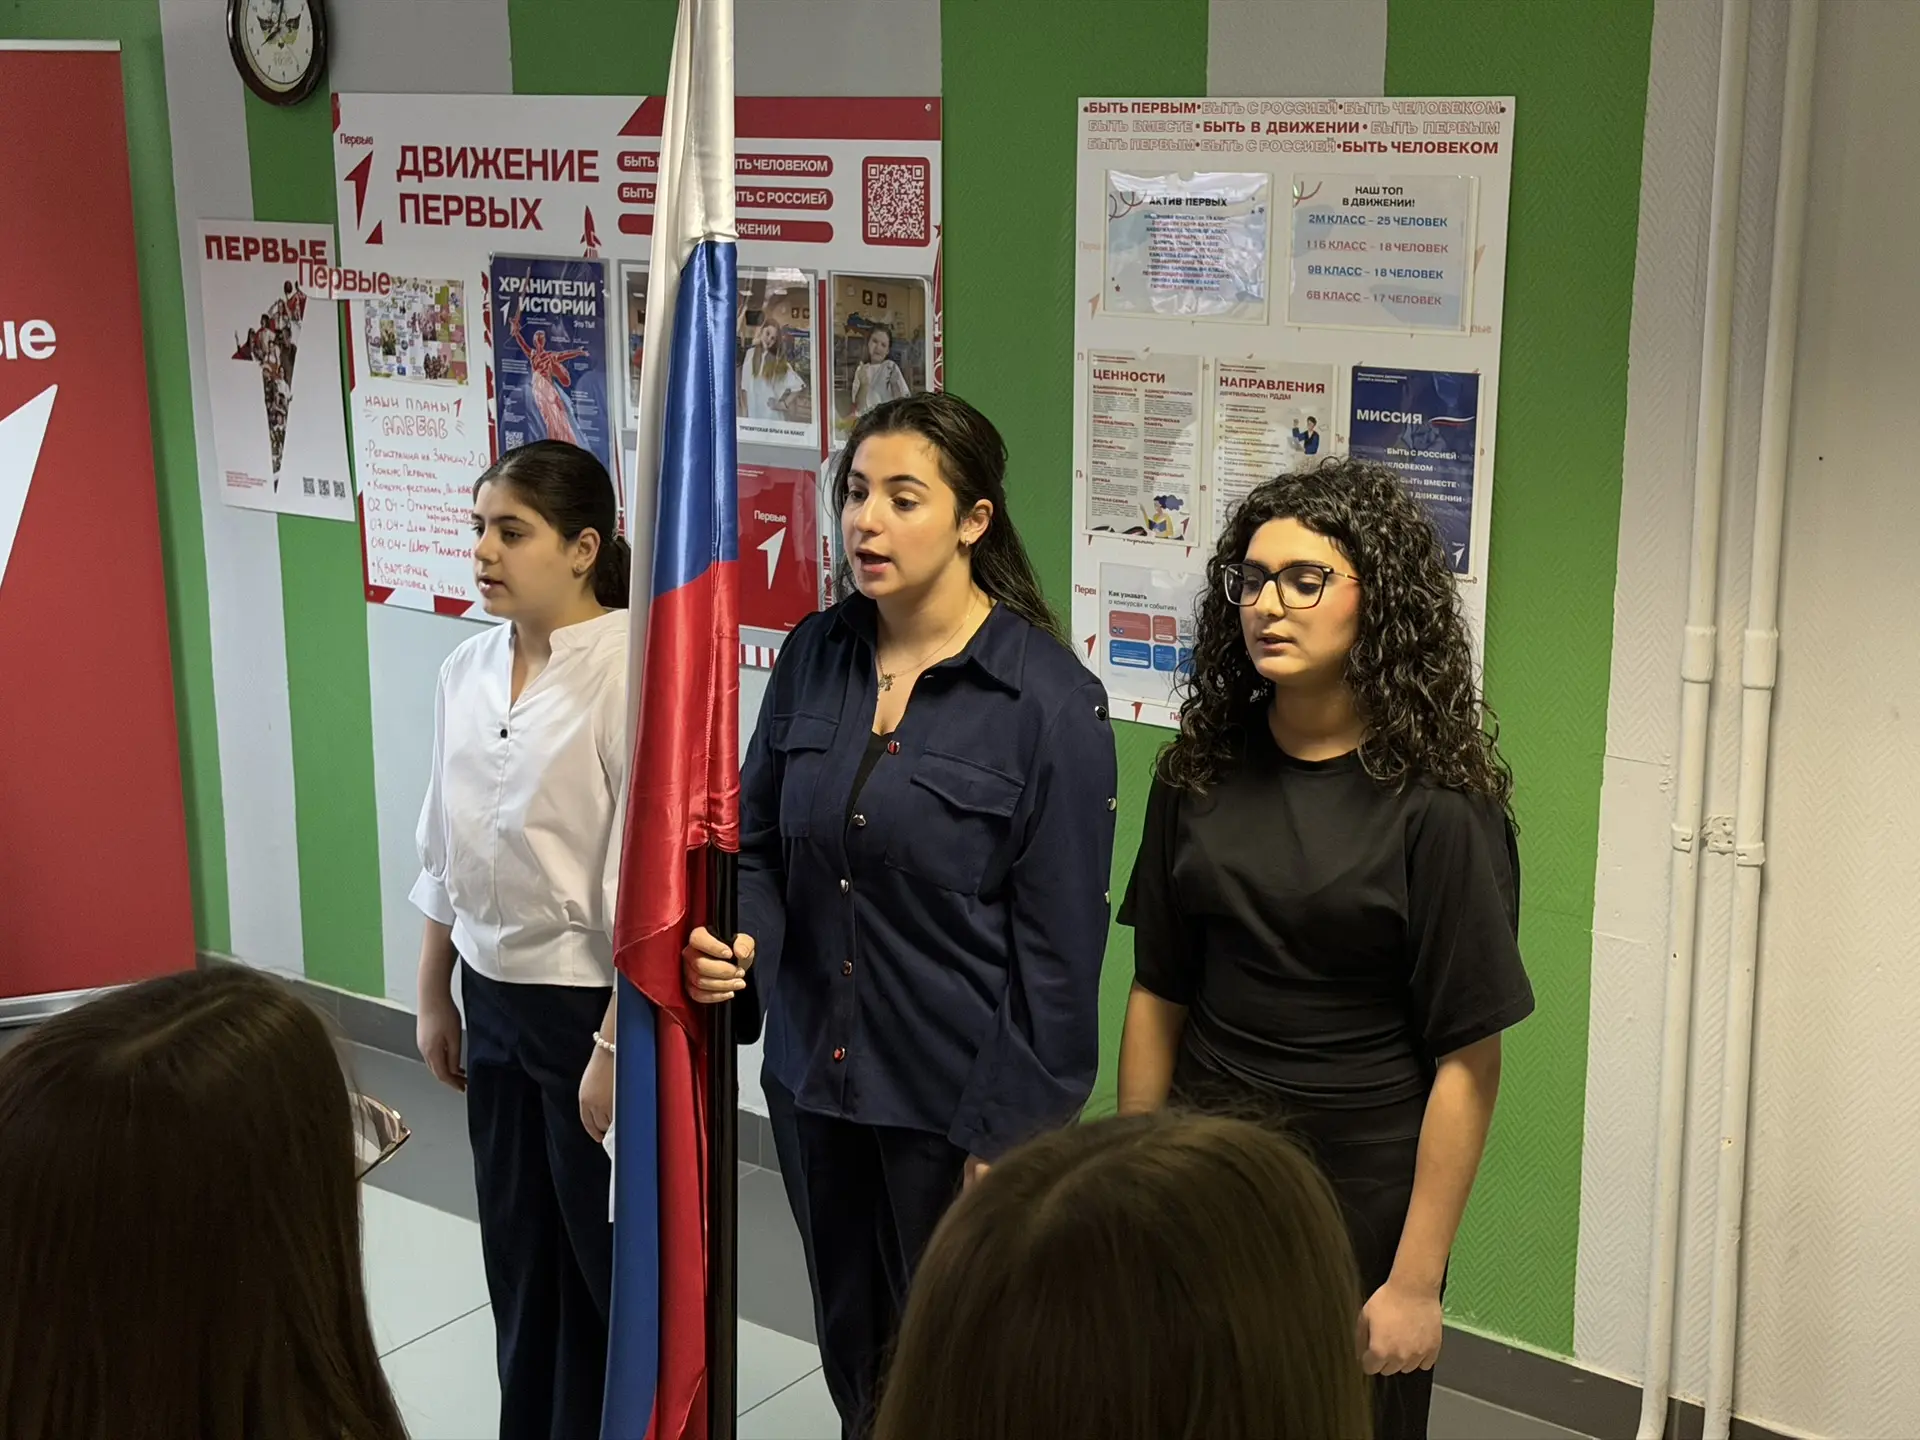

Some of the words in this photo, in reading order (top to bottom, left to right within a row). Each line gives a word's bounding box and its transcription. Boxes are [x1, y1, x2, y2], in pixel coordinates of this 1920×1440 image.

[1088, 102, 1128, 114] БЫТЬ
[1131, 102, 1196, 114] ПЕРВЫМ
[1202, 101, 1245, 115] БЫТЬ
[1247, 101, 1259, 115] С
[1260, 98, 1338, 115] РОССИЕЙ
[1344, 101, 1390, 115] БЫТЬ
[1392, 101, 1500, 115] ЧЕЛОВЕКОМ
[1088, 119, 1129, 133] БЫТЬ
[1132, 119, 1194, 133] ВМЕСТЕ
[1203, 121, 1245, 133] БЫТЬ
[1251, 121, 1261, 133] В
[1266, 121, 1360, 135] ДВИЖЕНИИ
[1371, 121, 1418, 134] БЫТЬ
[1423, 121, 1500, 135] ПЕРВЫМ
[340, 133, 374, 147] Первые
[1087, 137, 1128, 151] БЫТЬ
[1130, 138, 1196, 151] ПЕРВЫМ
[1200, 139, 1243, 152] БЫТЬ
[1246, 140, 1258, 152] С
[1260, 137, 1337, 153] РОССИЕЙ
[1342, 140, 1388, 153] БЫТЬ
[1391, 140, 1499, 154] ЧЕЛОВЕКОМ
[396, 145, 600, 184] ДВИЖЕНИЕ
[623, 155, 655, 168] БЫТЬ
[735, 159, 752, 171] ТЬ
[753, 159, 828, 172] ЧЕЛОВЕКОМ
[622, 186, 654, 199] БЫТЬ
[736, 191, 754, 203] ТЬ
[756, 192, 766, 204] С
[767, 189, 827, 205] РОССИЕЙ
[1355, 186, 1381, 195] НАШ
[1382, 187, 1404, 196] ТОП
[1149, 197, 1183, 206] АКТИВ
[1185, 197, 1228, 207] ПЕРВЫХ
[1342, 198, 1350, 206] В
[1351, 198, 1415, 208] ДВИЖЕНИИ!
[399, 193, 543, 231] ПЕРВЫХ
[1308, 214, 1326, 225] 2М
[1327, 215, 1367, 226] КЛАСС
[1377, 216, 1391, 226] 25
[1393, 216, 1448, 228] ЧЕЛОВЕК
[736, 223, 781, 236] ЖЕНИИ
[204, 234, 328, 266] ПЕРВЫЕ
[1328, 241, 1368, 251] КЛАСС
[1379, 242, 1392, 251] 18
[1394, 243, 1449, 254] ЧЕЛОВЕК
[299, 258, 391, 300] Первые
[1324, 266, 1363, 277] КЛАСС
[1374, 268, 1388, 278] 18
[1389, 268, 1444, 280] ЧЕЛОВЕК
[498, 276, 596, 297] ХРАНИТЕЛИ
[1323, 291, 1361, 302] КЛАСС
[1373, 294, 1386, 303] 17
[1388, 295, 1442, 306] ЧЕЛОВЕК
[519, 296, 596, 317] ИСТОРИИ
[1092, 368, 1166, 384] ЦЕННОСТИ
[1219, 376, 1326, 394] НАПРАВЛЕНИЯ
[1269, 393, 1292, 401] РДДМ
[1356, 408, 1423, 425] МИССИЯ
[1386, 447, 1409, 456] БЫТЬ
[1417, 449, 1457, 460] РОССИЕЙ
[1423, 479, 1457, 488] ВМЕСТЕ
[753, 510, 787, 524] Первые
[1074, 584, 1097, 597] Перв
[1108, 590, 1120, 598] Как
[1120, 592, 1148, 600] узнавать
